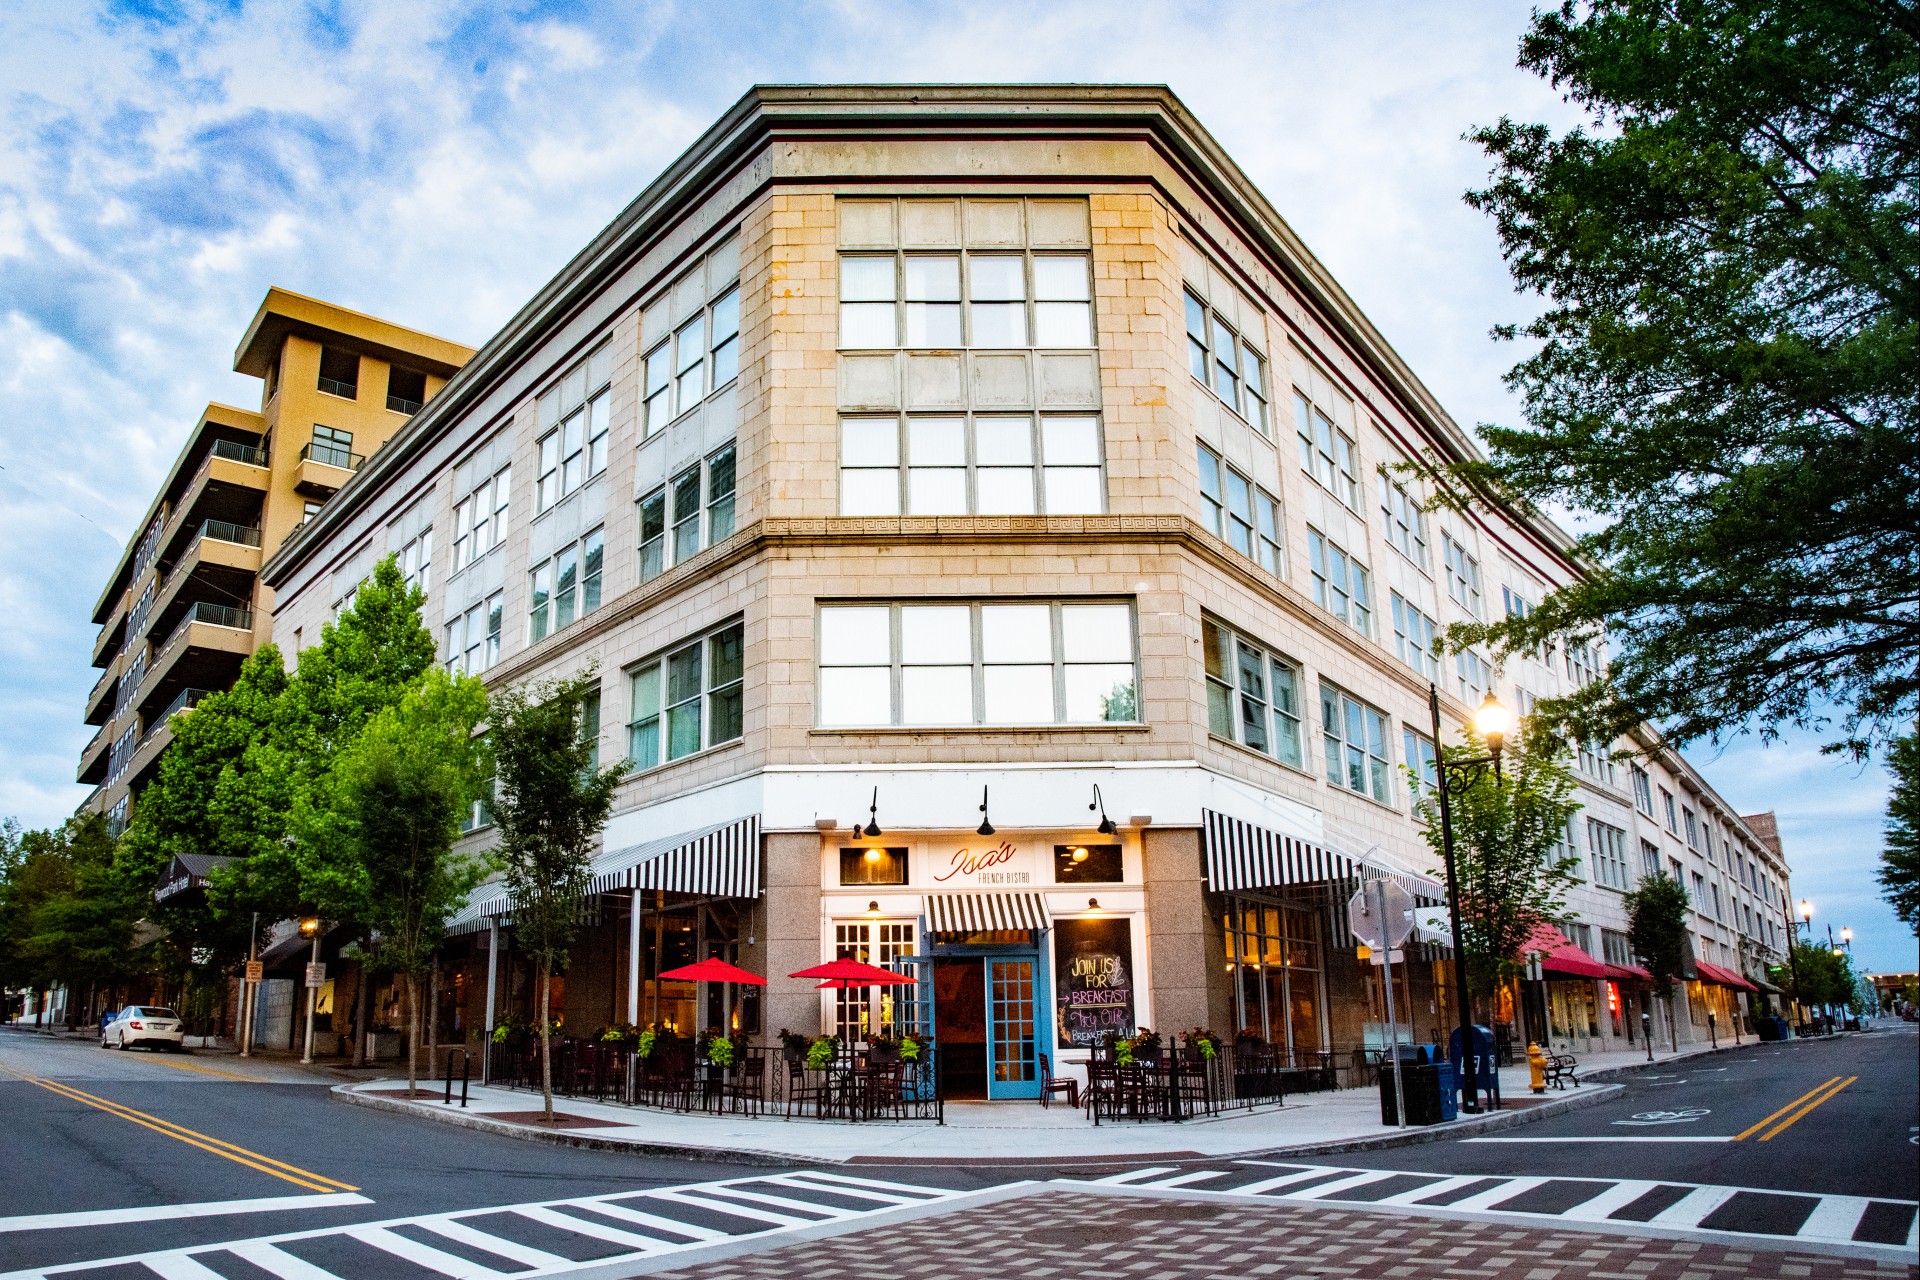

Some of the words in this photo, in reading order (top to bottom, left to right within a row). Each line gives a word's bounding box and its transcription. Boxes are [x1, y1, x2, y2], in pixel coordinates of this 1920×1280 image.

[934, 841, 1016, 881] Isa's
[179, 873, 189, 890] Hotel
[978, 872, 1004, 884] FRENCH
[1006, 872, 1030, 883] BISTRO
[1072, 958, 1096, 976] JOIN
[1100, 958, 1114, 974] US
[1086, 975, 1108, 988] FOR
[1072, 990, 1129, 1004] BREAKFAST
